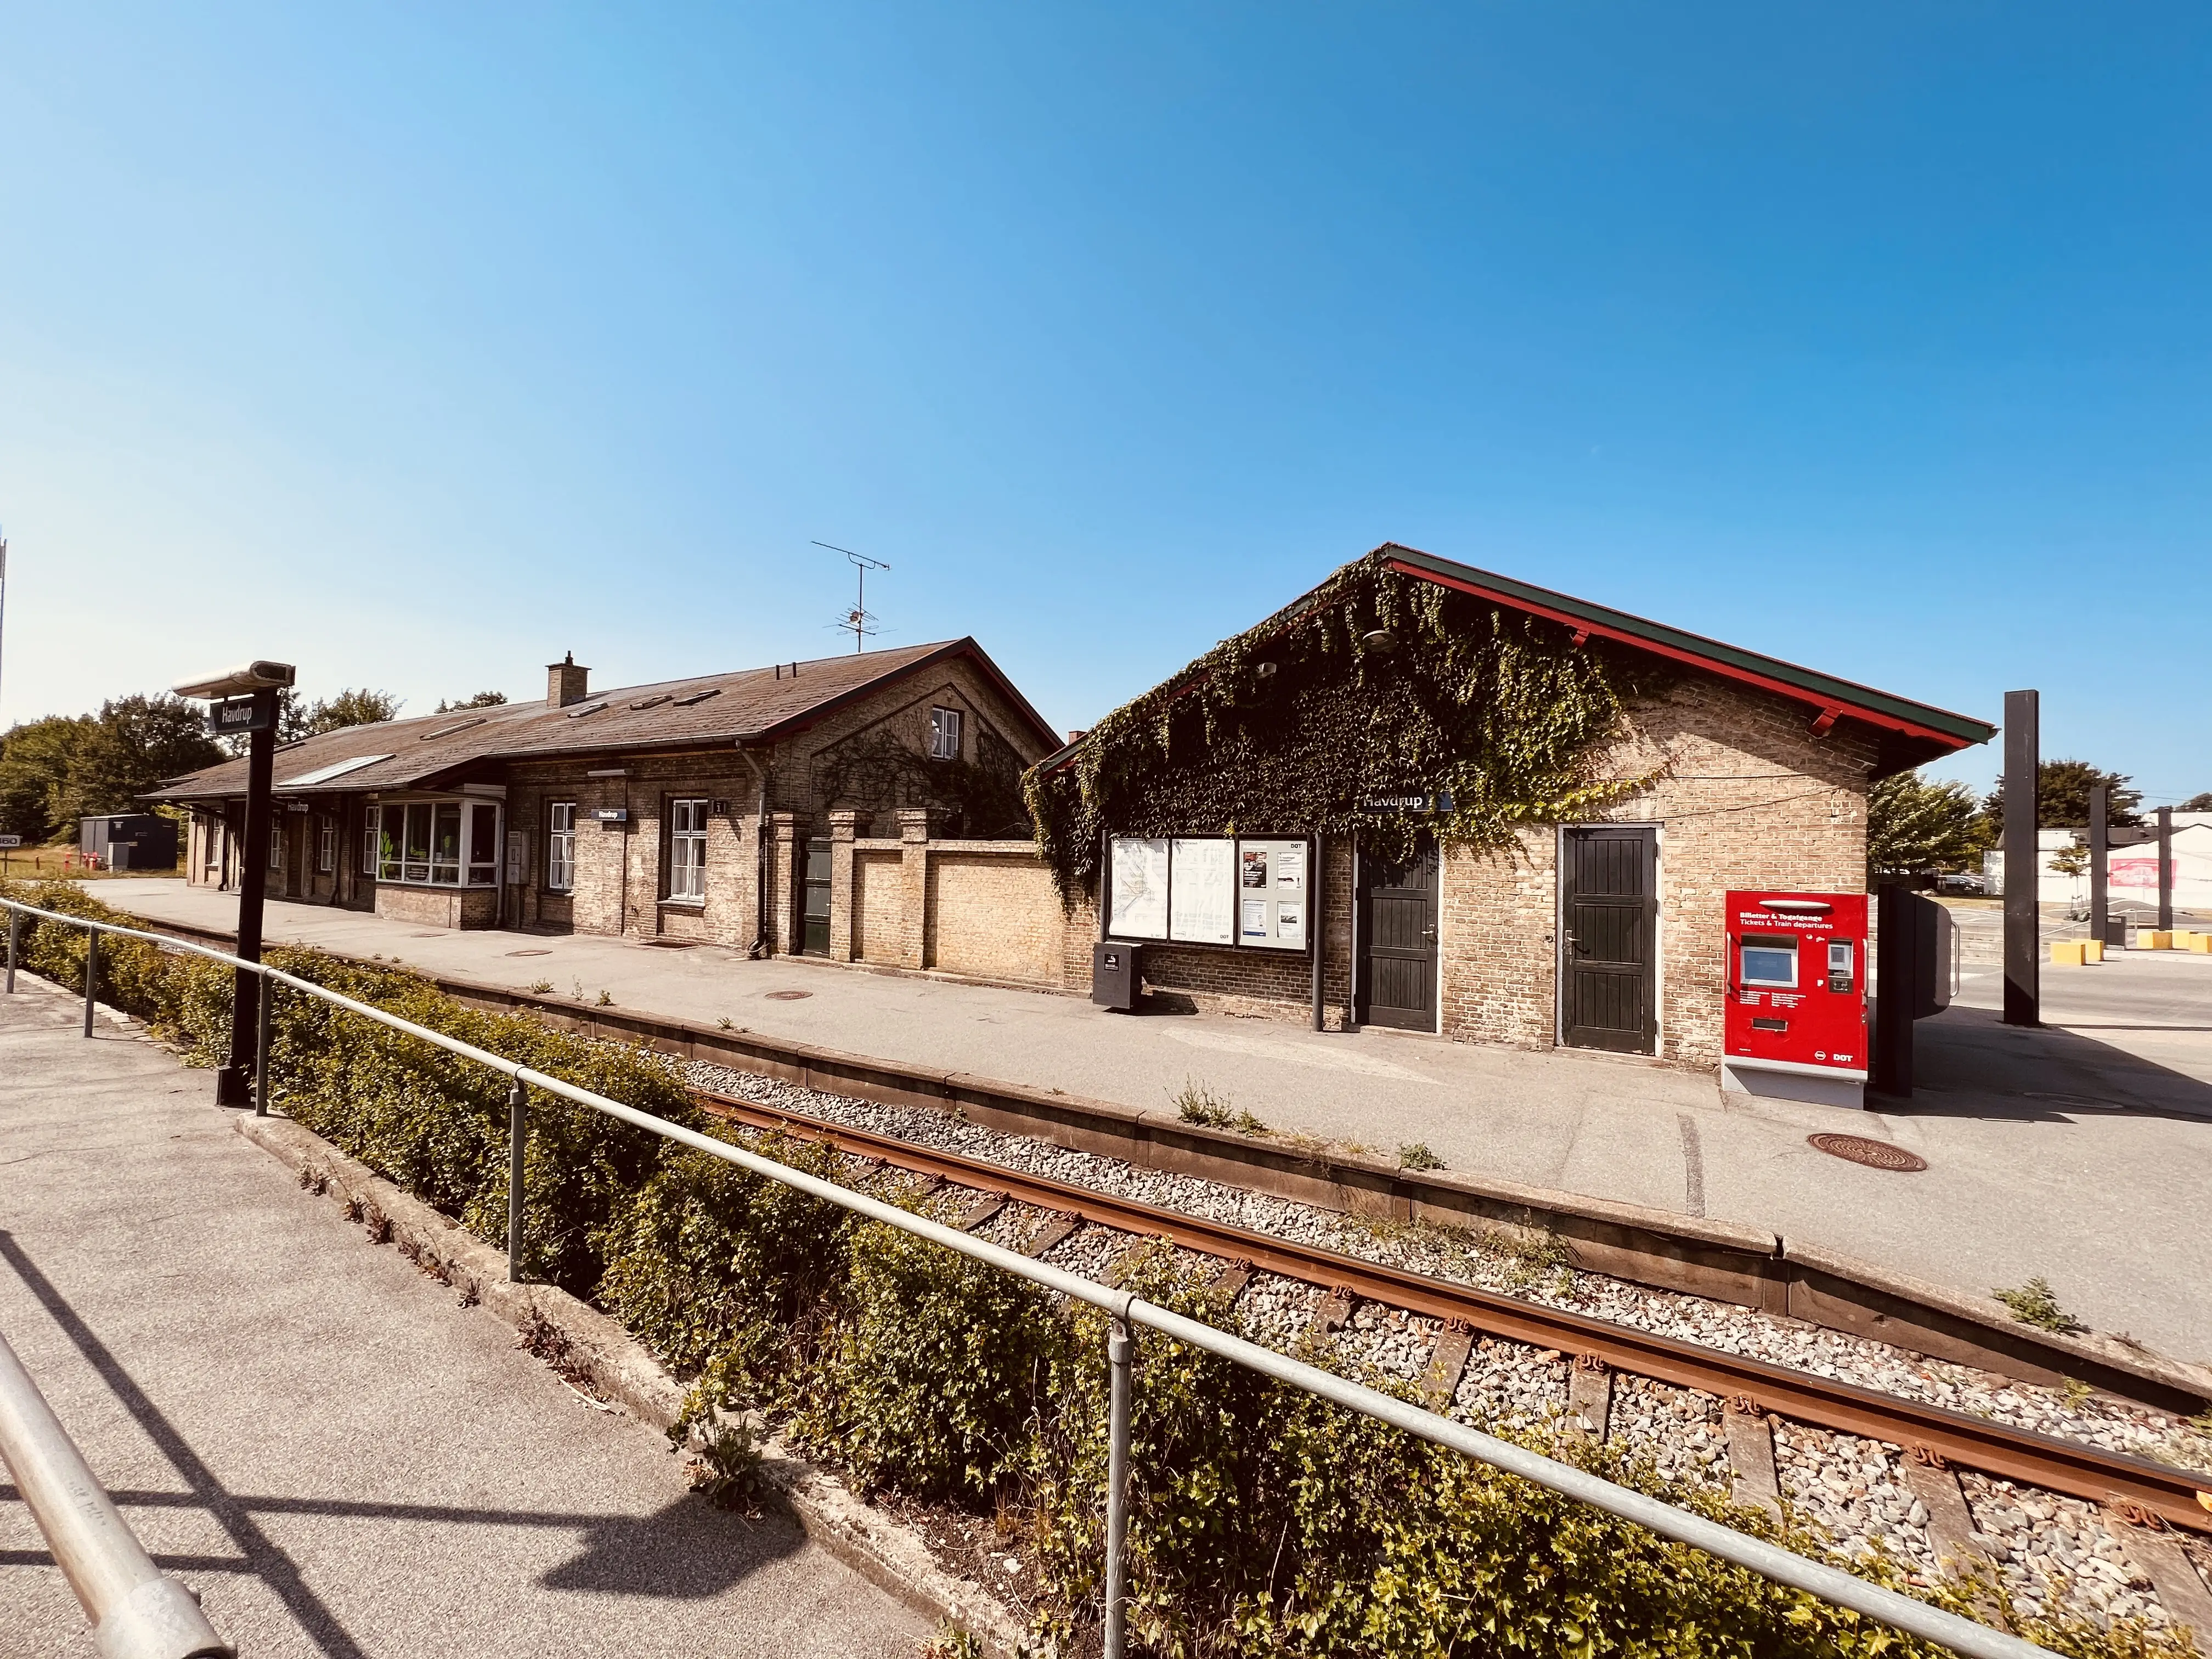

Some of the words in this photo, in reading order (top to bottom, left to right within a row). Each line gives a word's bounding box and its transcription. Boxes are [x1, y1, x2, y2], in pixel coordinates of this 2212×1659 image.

[222, 704, 252, 725] Havdrup
[1364, 794, 1423, 809] Havdrup
[1793, 921, 1833, 929] departures
[1833, 1053, 1854, 1062] DOT
